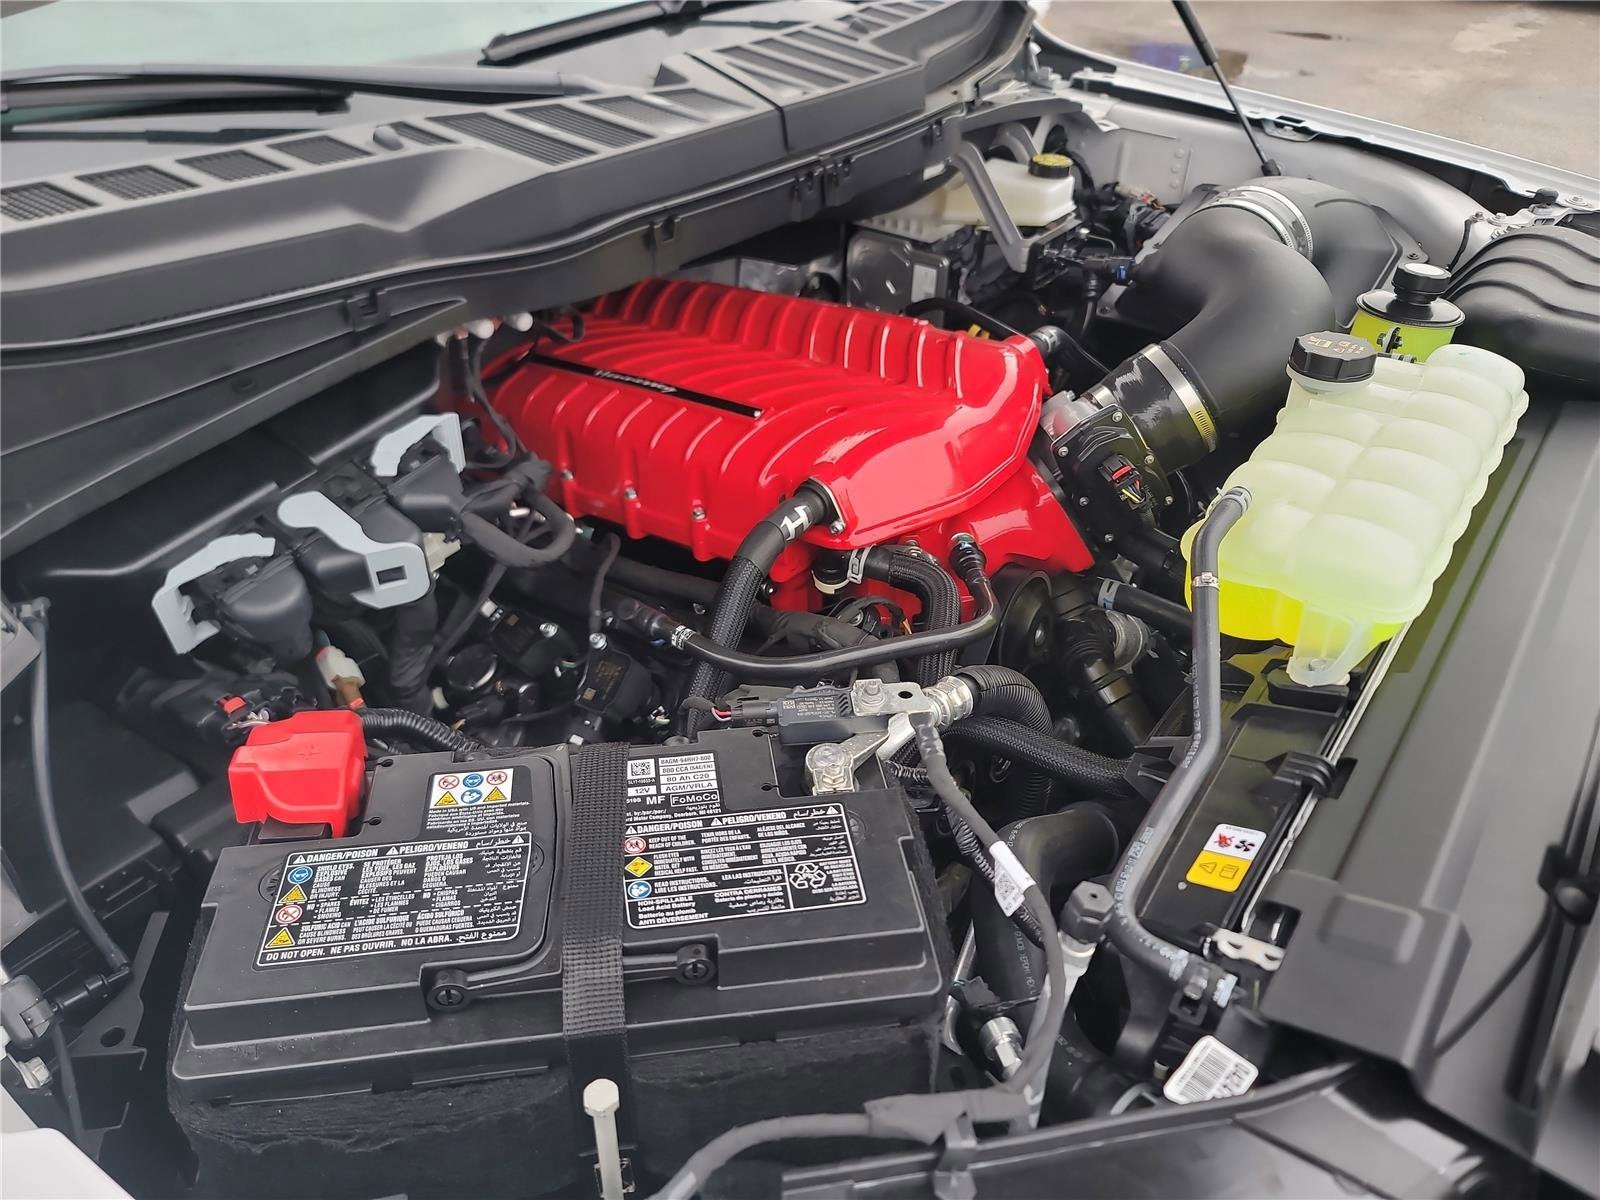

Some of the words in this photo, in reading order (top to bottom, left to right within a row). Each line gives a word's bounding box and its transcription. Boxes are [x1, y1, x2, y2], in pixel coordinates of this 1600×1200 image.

[666, 782, 712, 792] AGM/VRLA
[647, 796, 666, 805] MF
[673, 793, 717, 804] FoMoCo
[722, 811, 786, 825] PELIGRO/VENENO
[637, 820, 703, 834] DANGER/POISON
[399, 841, 468, 854] PELIGRO/VENENO
[306, 849, 378, 863] DANGER/POISON
[349, 897, 370, 906] ÉVITEZ
[638, 896, 693, 906] NON-SPILLABLE
[657, 912, 709, 923] DÉVERSEMENT
[427, 934, 453, 943] ABRA.
[344, 944, 360, 952] PAS
[362, 940, 397, 950] OUVRIR.
[281, 951, 299, 959] NOT
[300, 948, 326, 957] OPEN.
